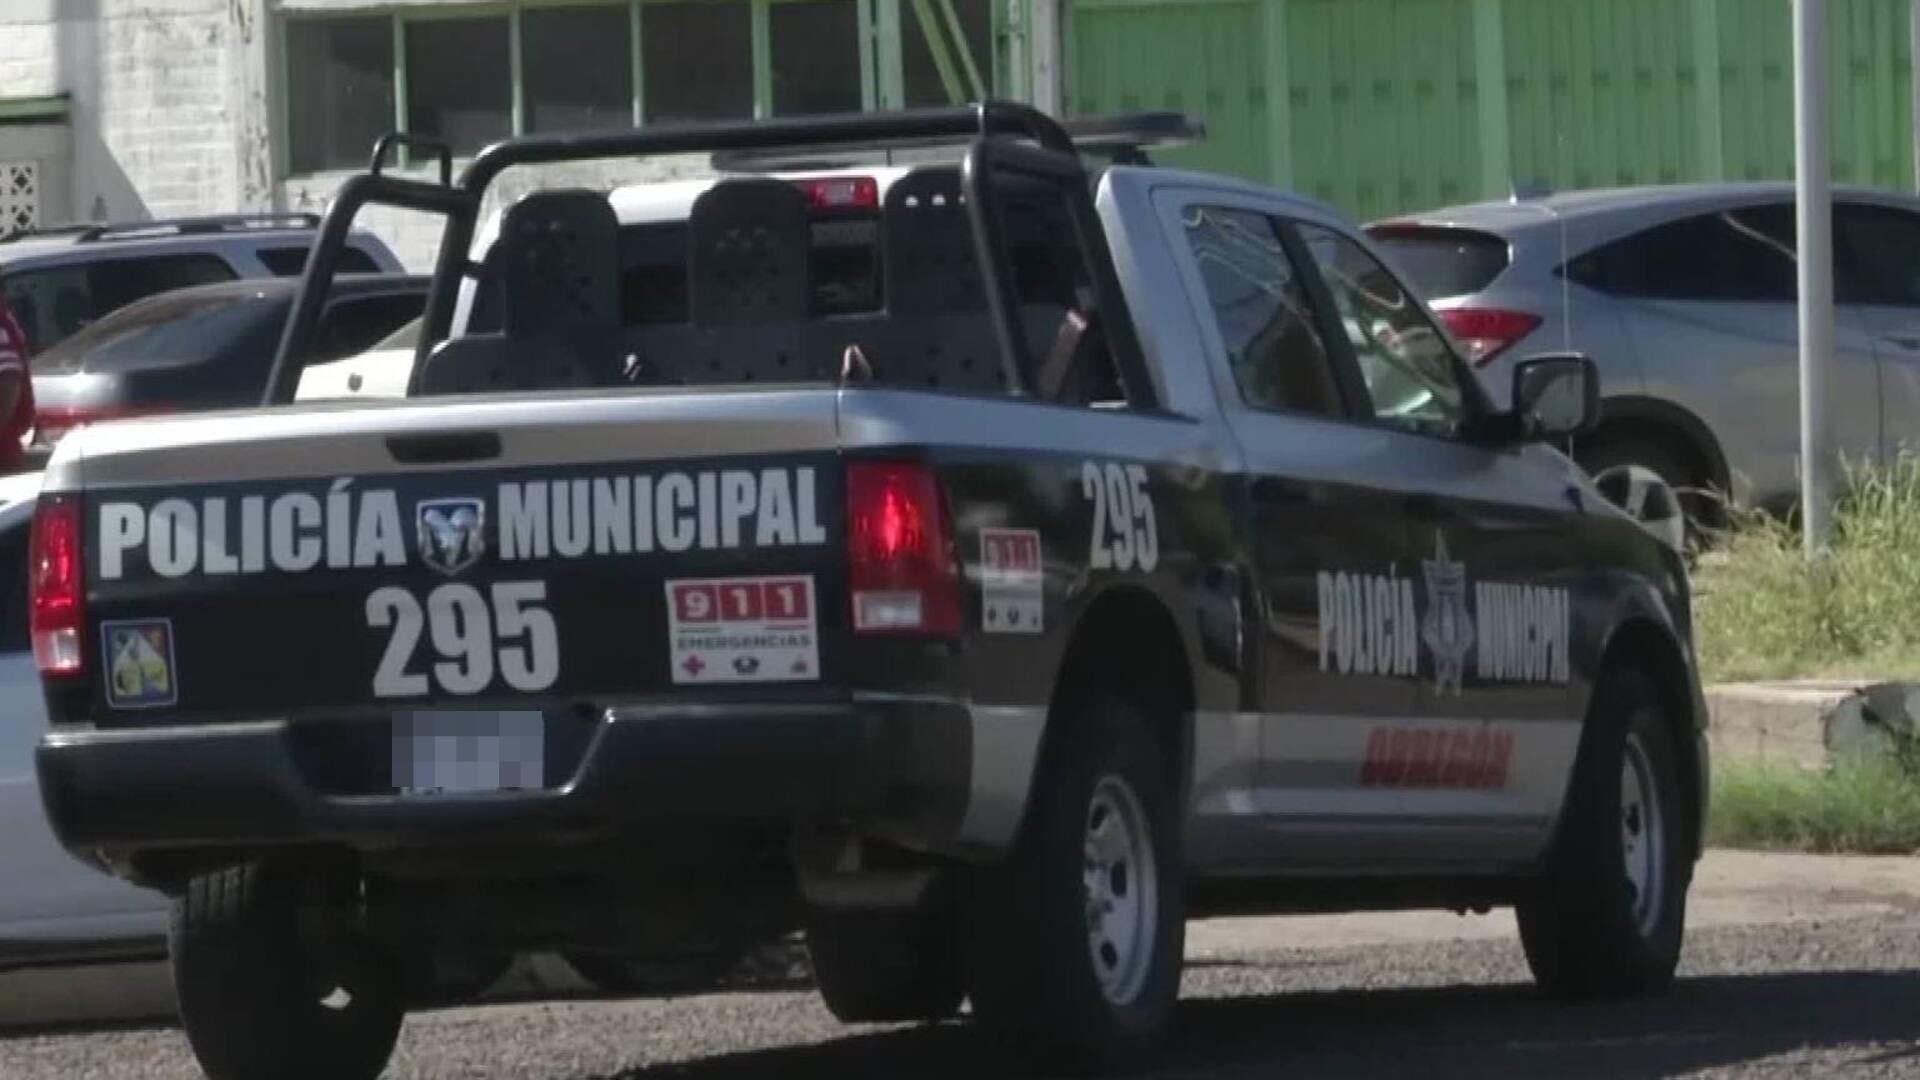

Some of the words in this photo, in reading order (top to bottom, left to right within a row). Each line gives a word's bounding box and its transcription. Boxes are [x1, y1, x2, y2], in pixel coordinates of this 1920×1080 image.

[98, 477, 407, 580] POLICÍA
[498, 467, 826, 561] MUNICIPAL
[1082, 460, 1159, 573] 295
[365, 580, 560, 696] 295
[676, 635, 813, 650] EMERGENCIAS
[685, 587, 796, 620] 911
[1317, 562, 1418, 675] POLICÍA
